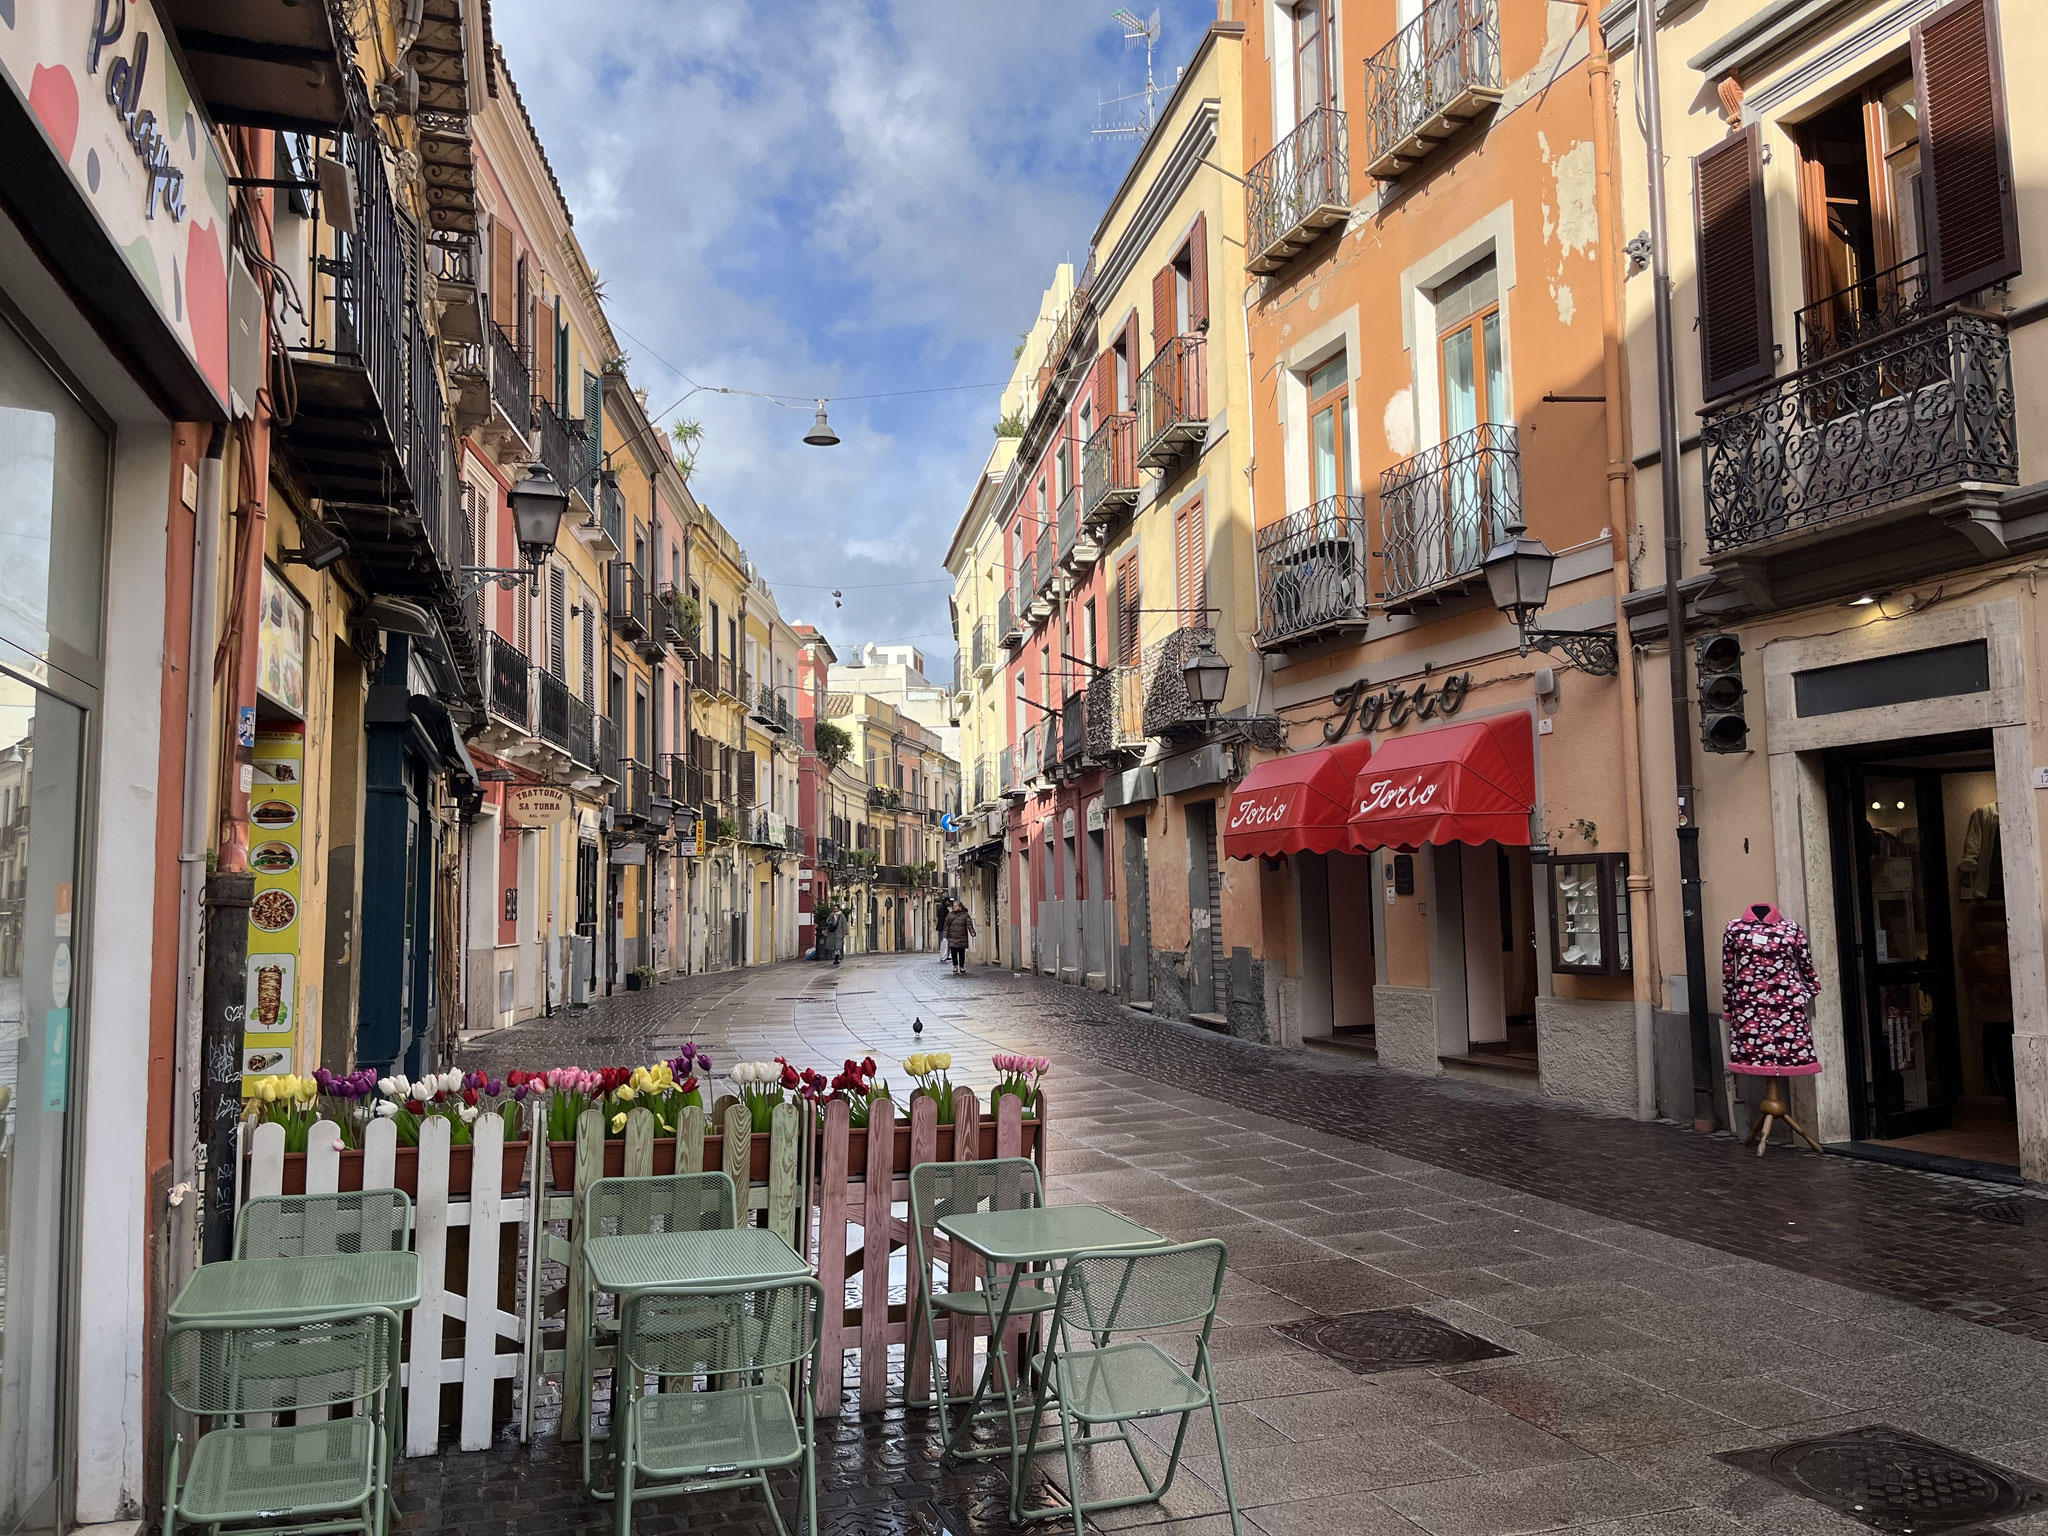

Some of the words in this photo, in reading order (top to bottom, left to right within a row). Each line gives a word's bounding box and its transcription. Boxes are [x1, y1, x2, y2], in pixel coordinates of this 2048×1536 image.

[516, 788, 563, 801] TRATTORIA
[518, 802, 530, 811] SA
[533, 802, 560, 811] TURRA
